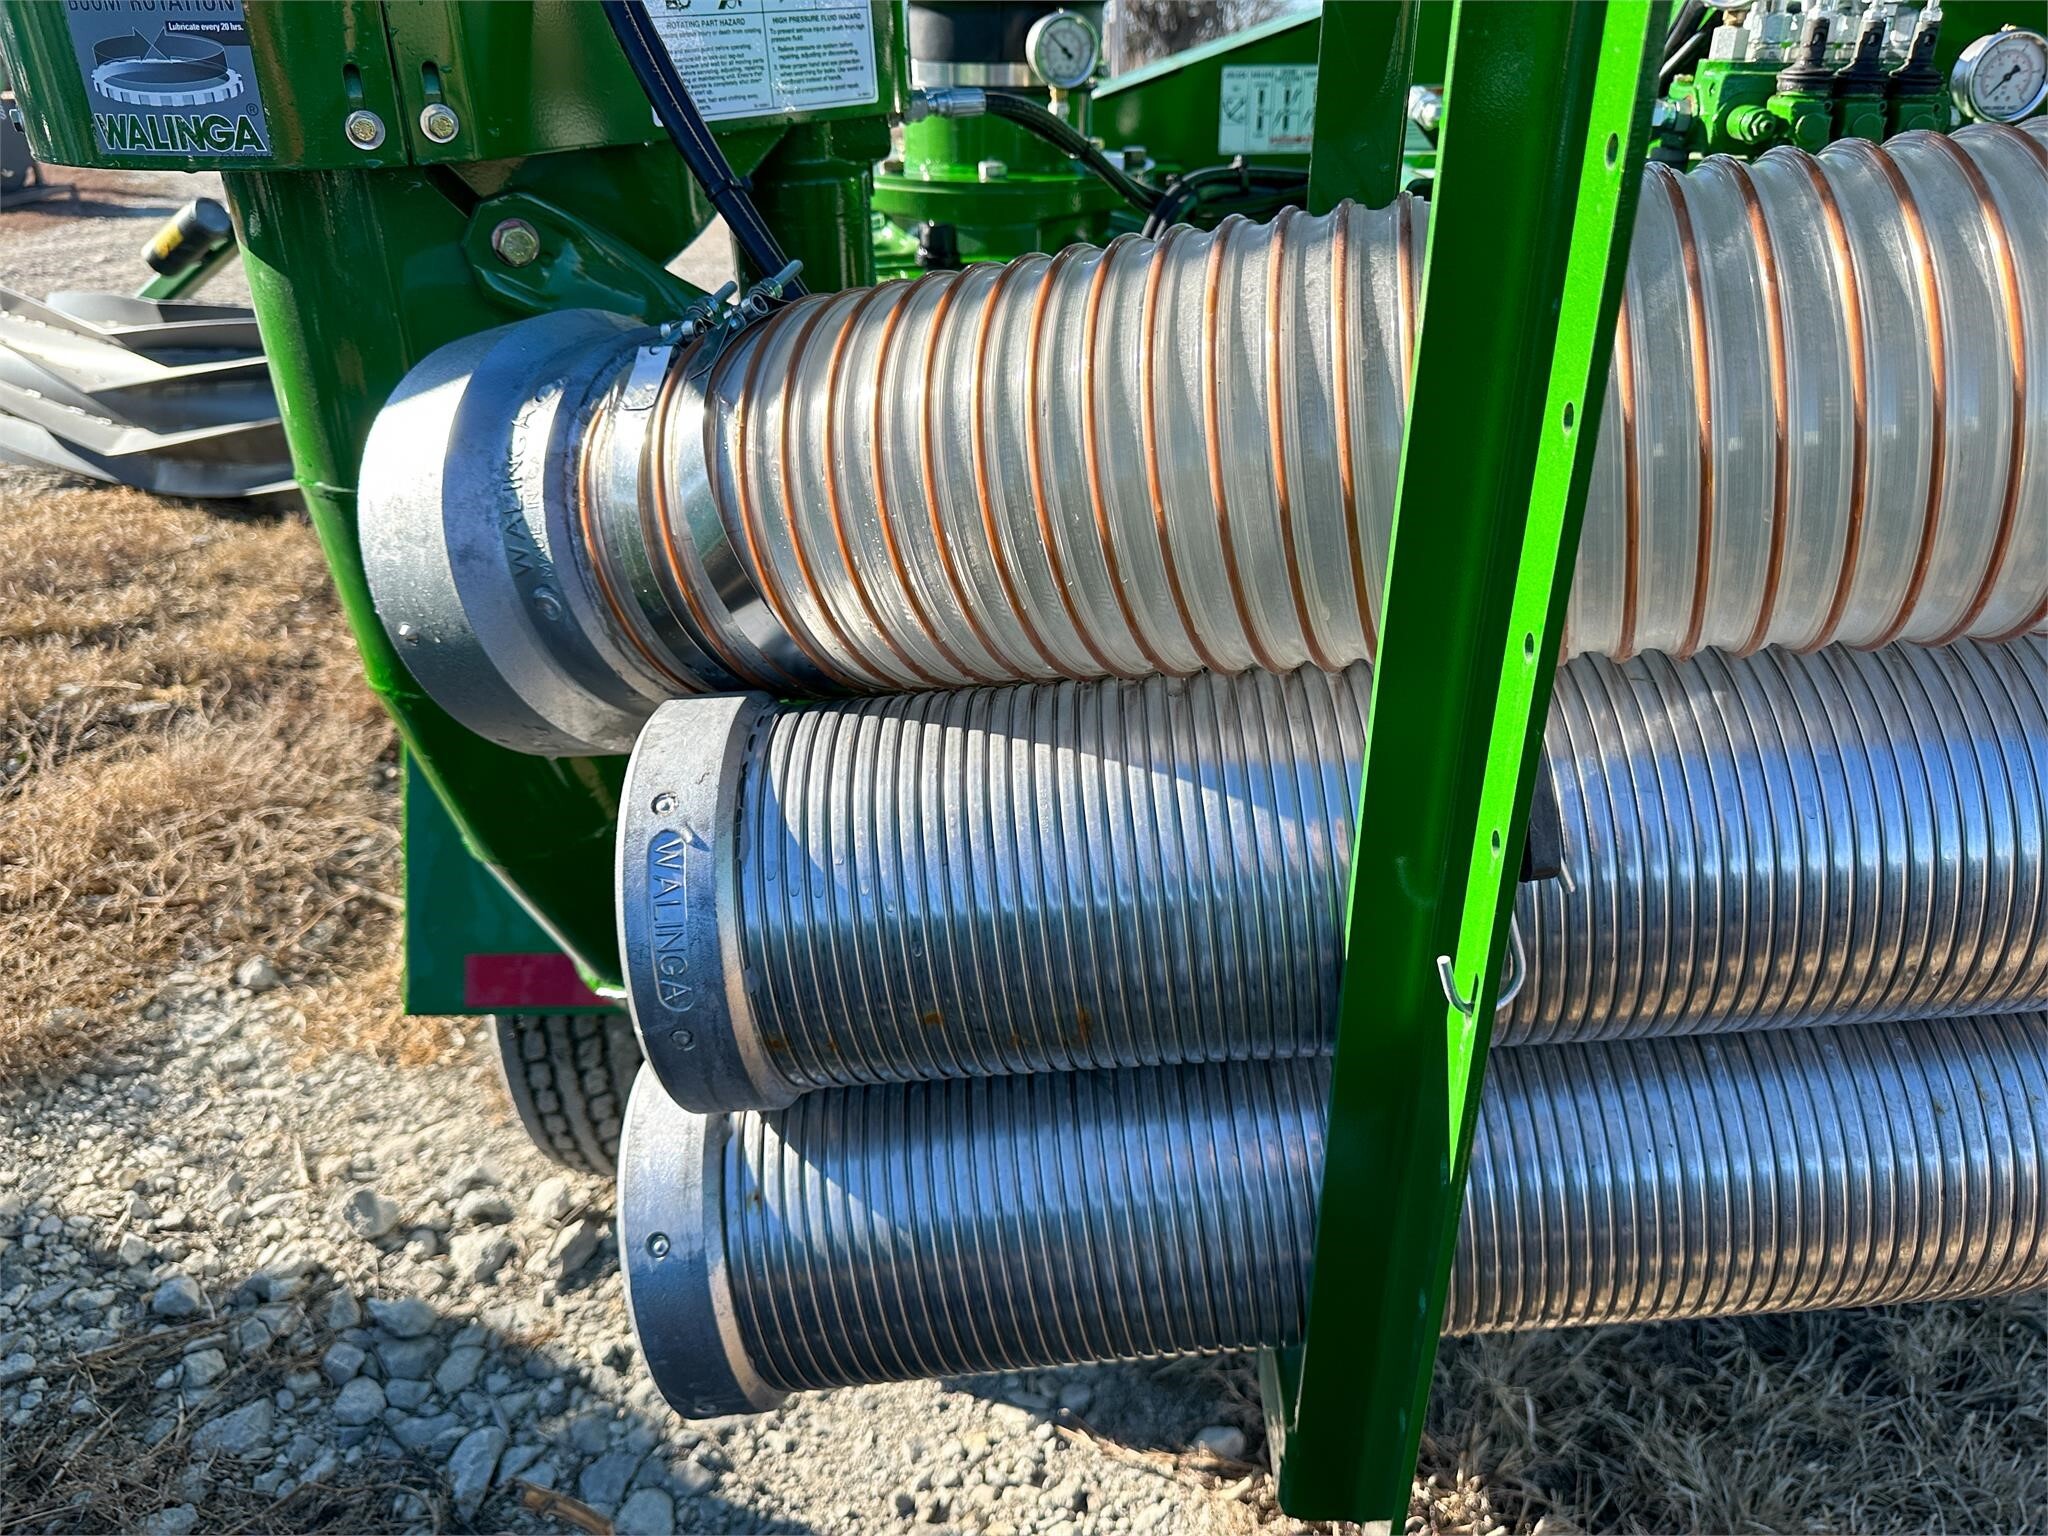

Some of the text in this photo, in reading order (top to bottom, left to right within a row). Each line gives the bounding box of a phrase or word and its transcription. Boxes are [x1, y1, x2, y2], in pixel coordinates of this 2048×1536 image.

[168, 22, 244, 33] Lubricate every 20 hrs.
[667, 20, 699, 29] ROTATING
[719, 17, 745, 26] HAZARD
[788, 15, 819, 23] PRESSURE
[838, 12, 861, 20] HAZARD
[94, 113, 268, 152] WALINGA
[503, 409, 537, 578] WALINGA
[654, 837, 692, 1002] WALINGA
